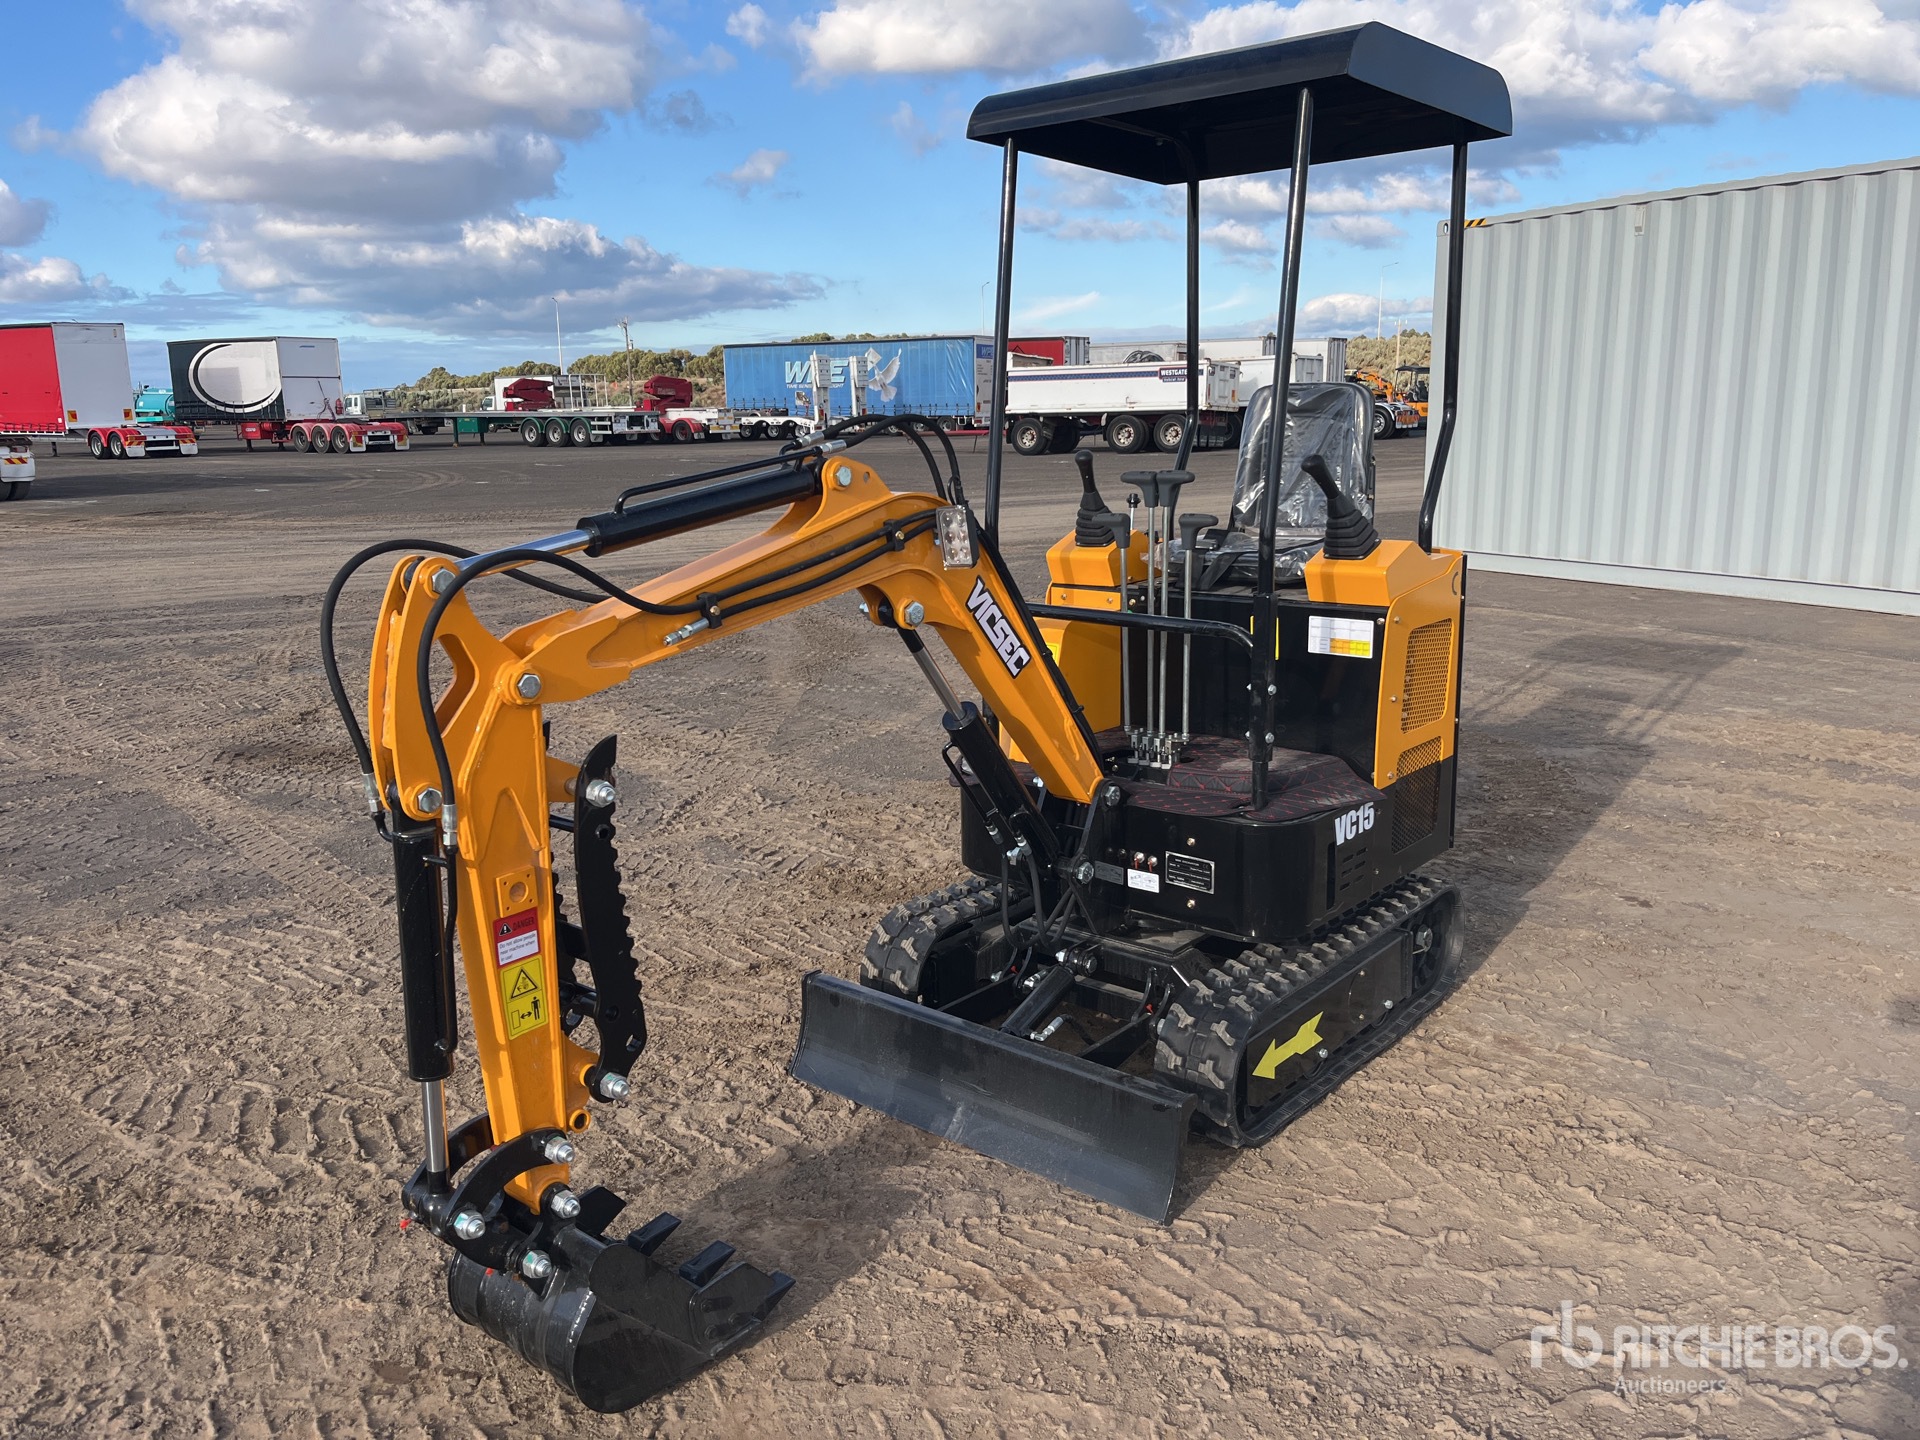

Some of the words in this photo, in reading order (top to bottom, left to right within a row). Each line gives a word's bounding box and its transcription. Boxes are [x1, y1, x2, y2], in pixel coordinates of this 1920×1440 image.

[785, 359, 849, 384] WE
[966, 577, 1031, 677] VICSEC
[1334, 801, 1375, 846] VC15
[512, 917, 535, 931] DANGER
